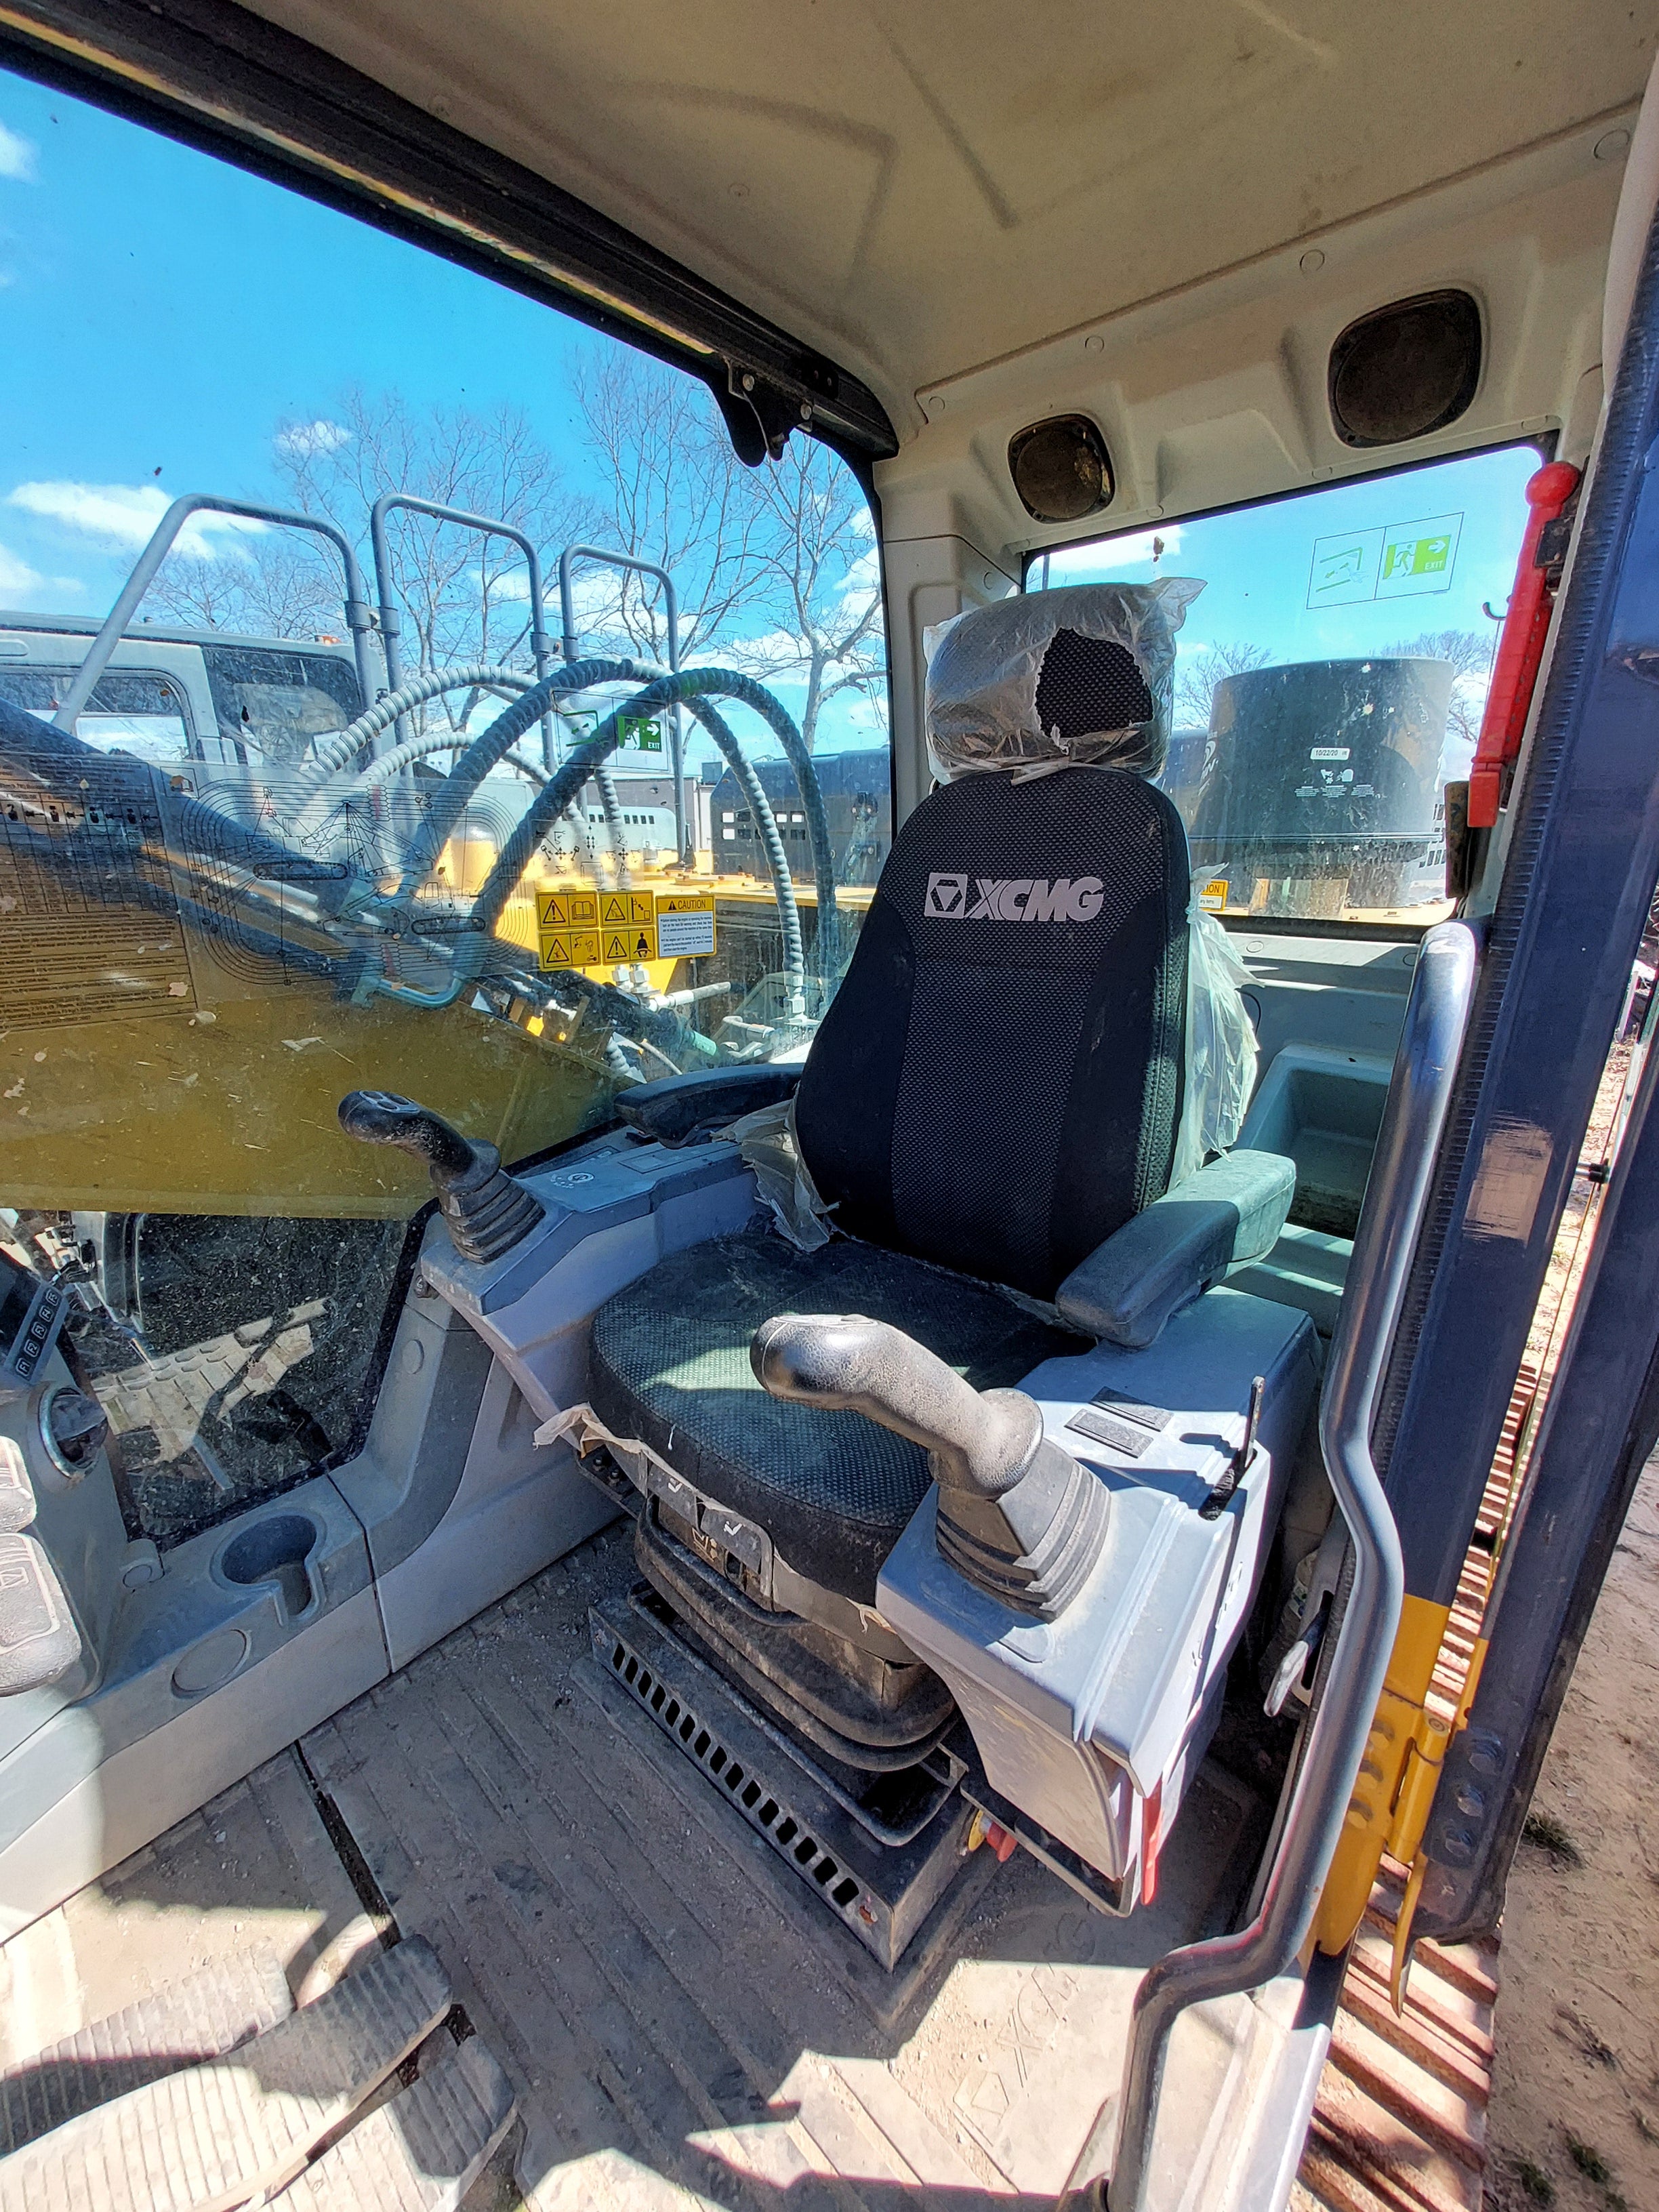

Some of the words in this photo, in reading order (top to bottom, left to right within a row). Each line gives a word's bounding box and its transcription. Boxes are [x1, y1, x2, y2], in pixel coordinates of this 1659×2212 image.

[1425, 560, 1443, 571] EXIT
[647, 741, 660, 750] EXIT
[678, 899, 706, 909] CAUTION
[964, 876, 1104, 922] XCMG
[19, 1361, 30, 1372] F1
[27, 1343, 37, 1354] F2
[41, 1308, 51, 1319] F4
